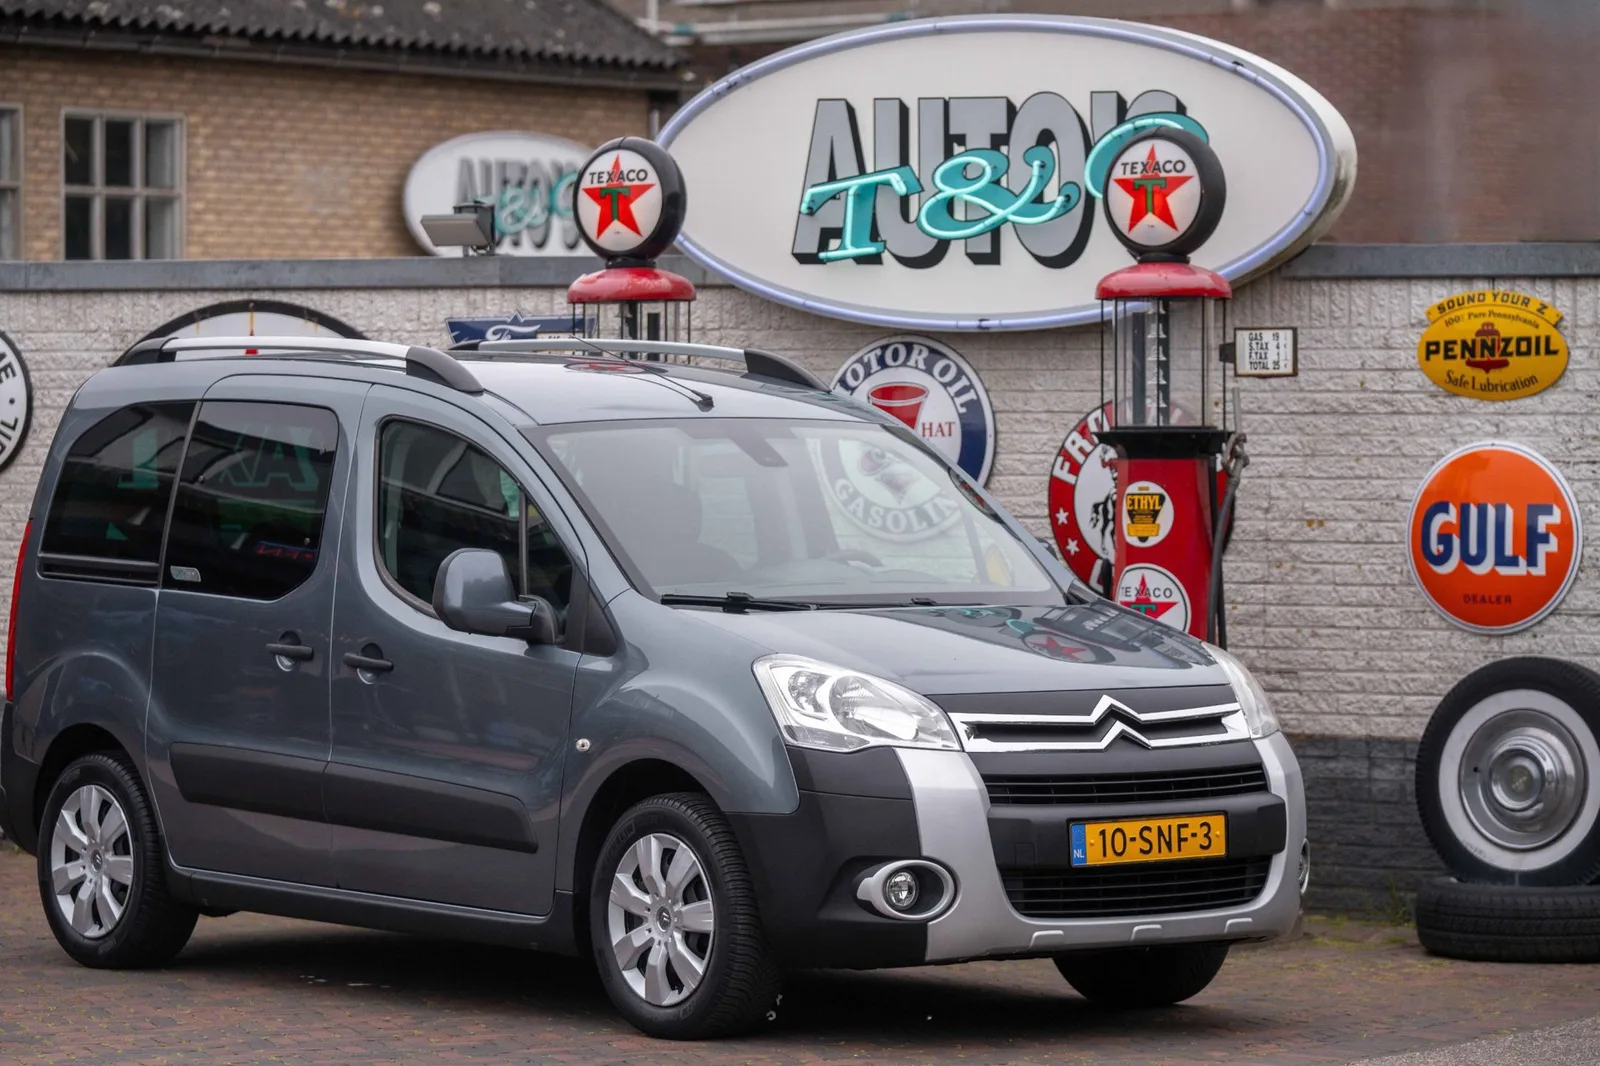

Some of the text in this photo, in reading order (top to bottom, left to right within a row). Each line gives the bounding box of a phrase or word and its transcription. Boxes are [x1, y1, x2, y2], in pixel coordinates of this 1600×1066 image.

[1121, 159, 1186, 176] TEXACO
[589, 168, 648, 185] TEXACO
[800, 165, 925, 262] T
[917, 147, 1081, 239] &
[1437, 292, 1549, 315] SOUND YOUR Z
[1467, 310, 1487, 321] Pure
[1488, 309, 1540, 330] Pennsylvania
[1248, 332, 1264, 341] GAS
[1248, 342, 1269, 351] S.TAX
[1425, 335, 1559, 362] PENNZOIL
[1248, 361, 1270, 371] TOTAL
[932, 358, 979, 414] OIL
[1444, 369, 1539, 393] Safe Lubrication
[921, 421, 956, 438] HAT
[1127, 495, 1161, 510] ETHYL
[1421, 501, 1562, 577] GULF
[1121, 585, 1173, 599] TEXACO
[1463, 594, 1513, 605] DEALER
[1073, 821, 1213, 859] NL 10-SNF-3
